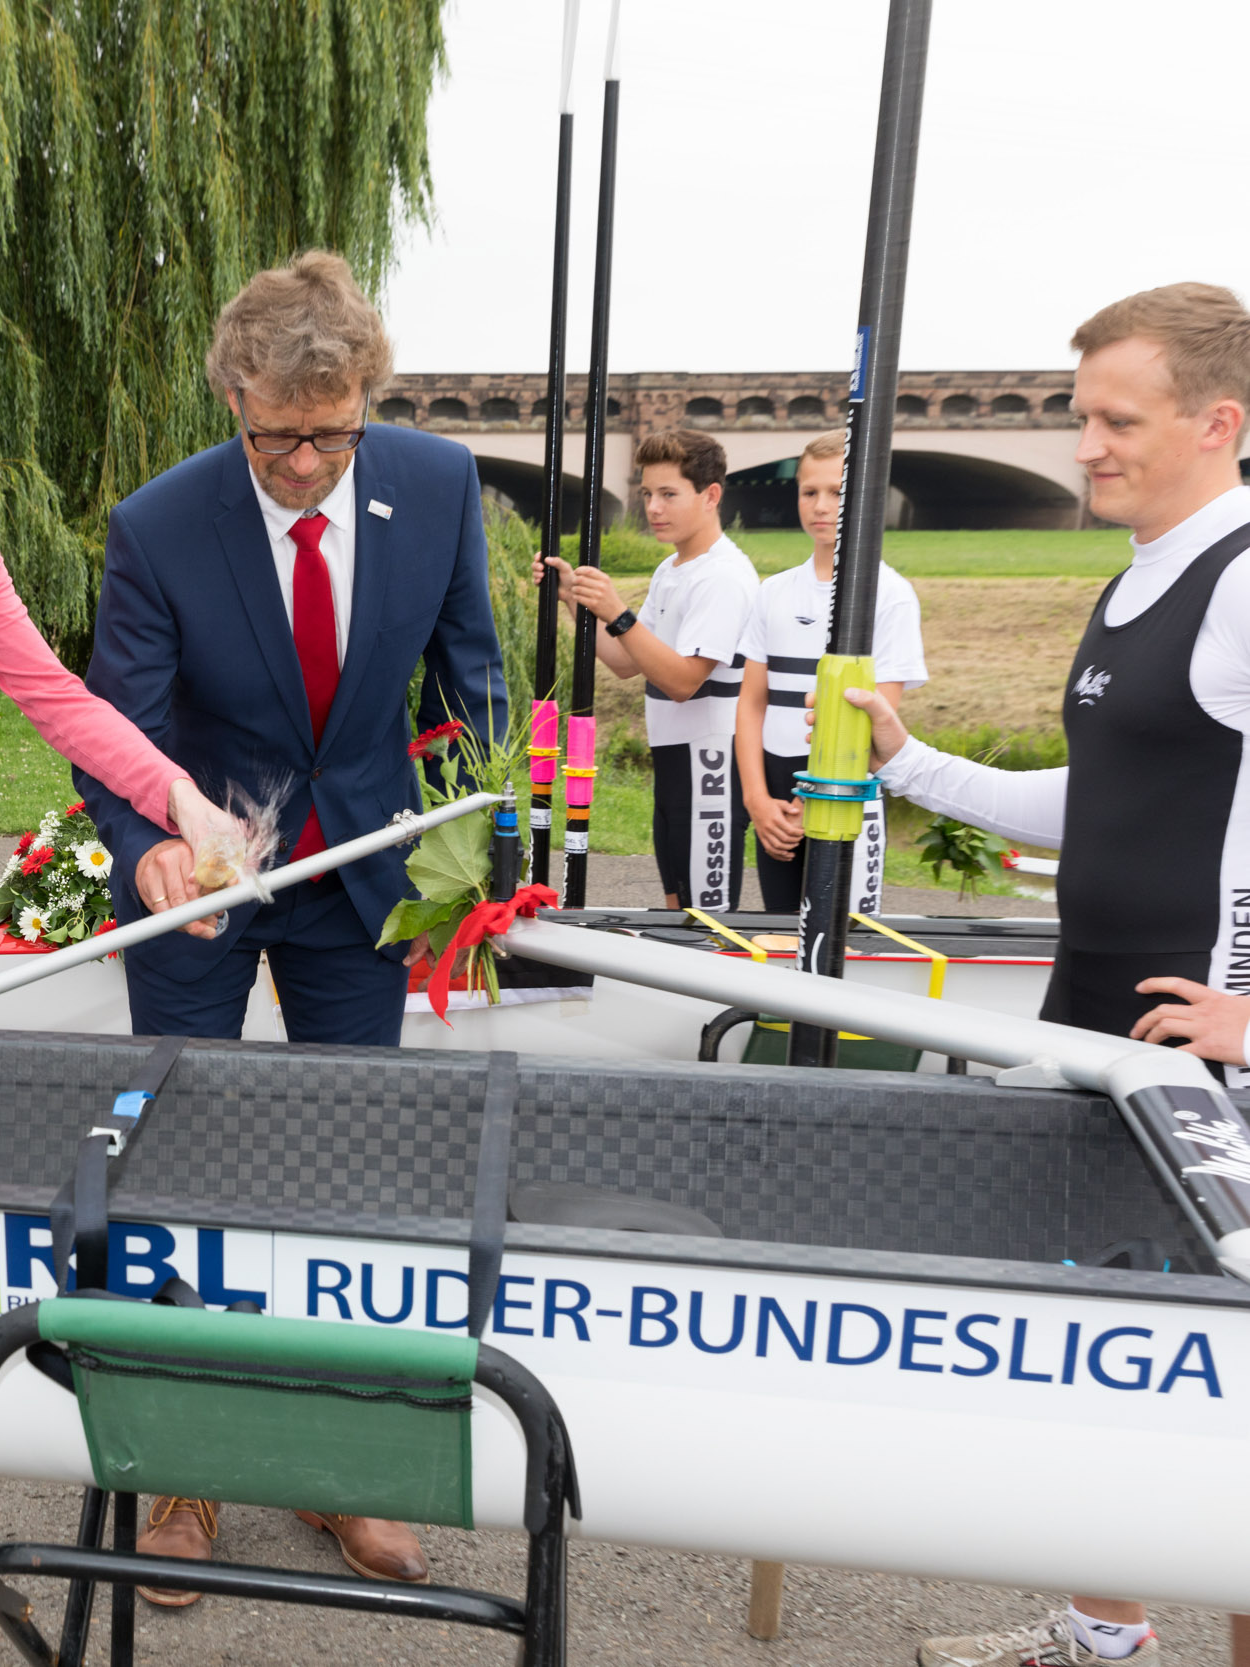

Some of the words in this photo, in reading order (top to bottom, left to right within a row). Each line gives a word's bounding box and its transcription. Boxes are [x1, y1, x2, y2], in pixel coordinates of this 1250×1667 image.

[699, 749, 725, 796] RC
[699, 811, 725, 908] Bessel
[859, 812, 880, 914] Bessel
[4, 1212, 267, 1310] RBL
[306, 1258, 1224, 1399] RUDER-BUNDESLIGA
